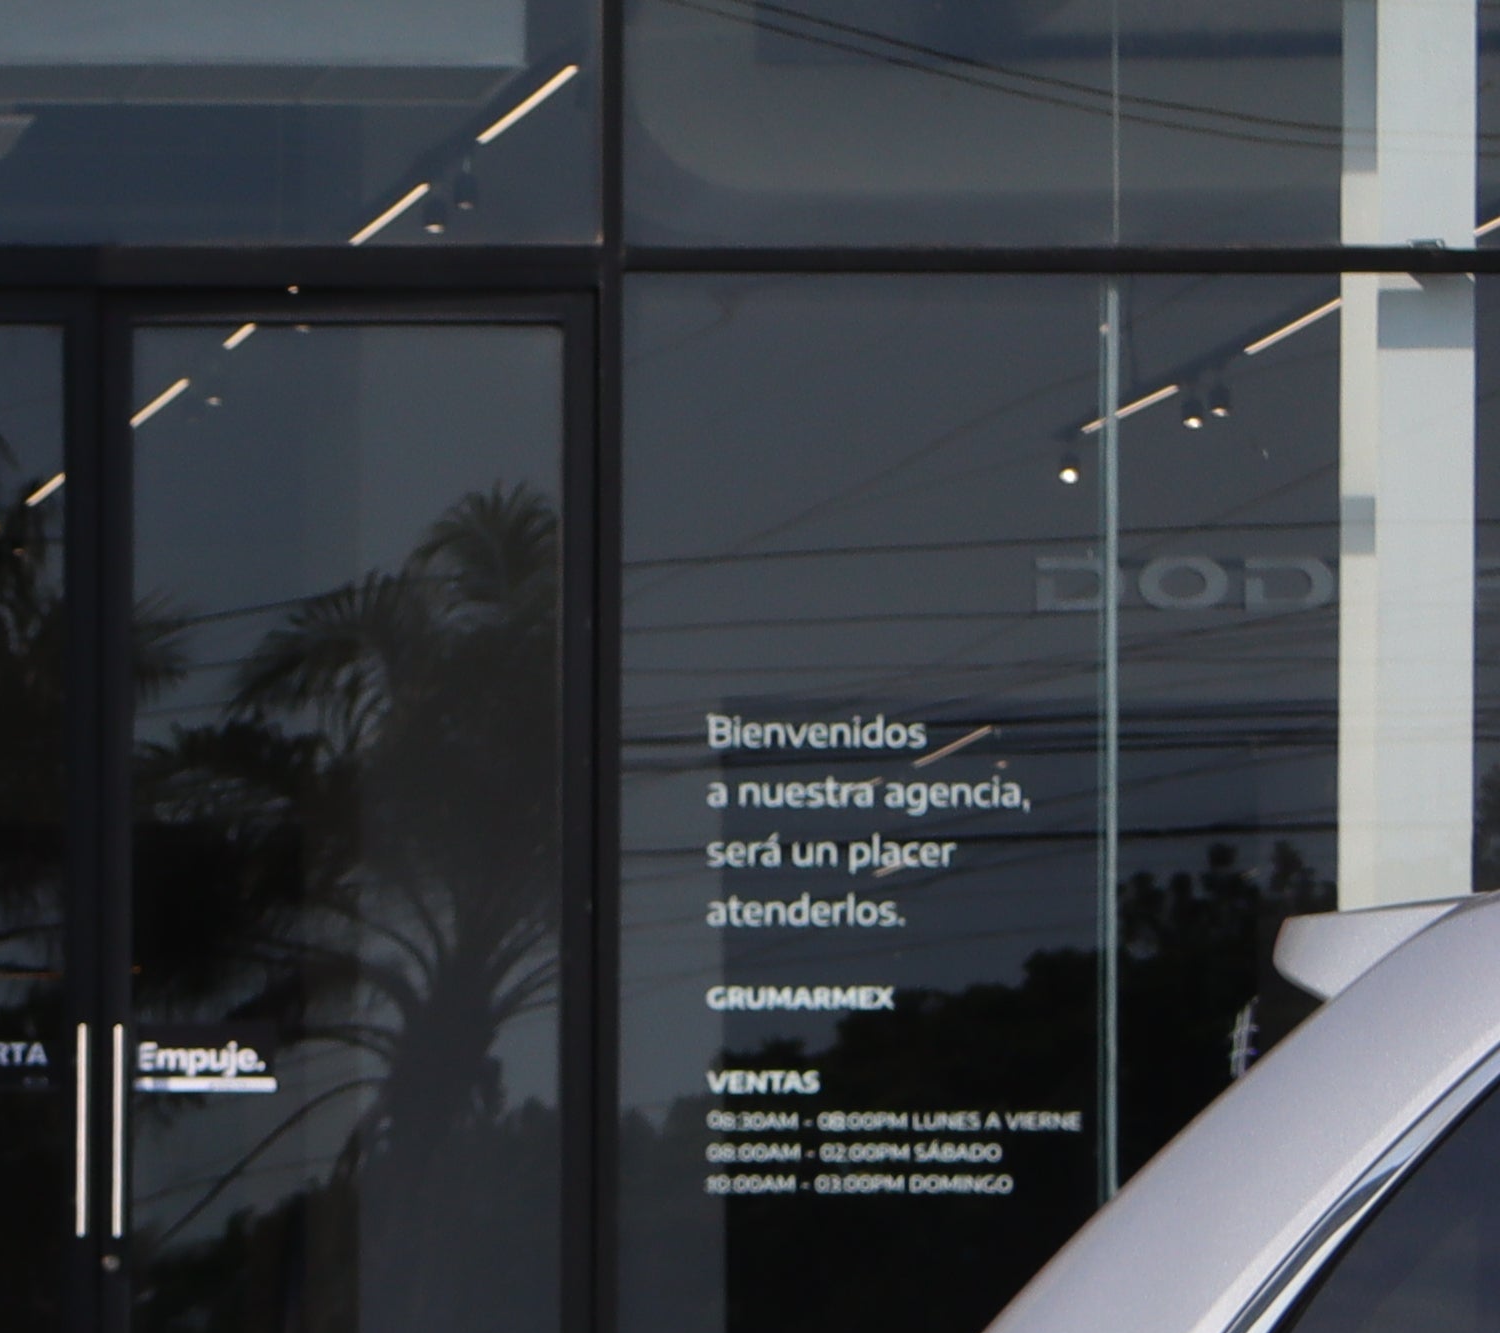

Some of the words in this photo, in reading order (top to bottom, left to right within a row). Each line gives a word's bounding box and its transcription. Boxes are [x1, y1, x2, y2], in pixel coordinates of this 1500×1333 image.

[1036, 556, 1336, 611] DOD
[706, 714, 927, 749] Bienvenidos
[706, 782, 728, 808] a
[738, 777, 874, 808] nuestra
[884, 777, 1031, 815] agencia,
[706, 834, 780, 868] será
[791, 841, 838, 867] un
[849, 834, 956, 874] placer
[706, 892, 906, 927] atenderlos.
[706, 986, 895, 1011] GRUMARMEX
[138, 1040, 266, 1077] Empuje.
[706, 1070, 820, 1094] VENTAS
[912, 1111, 981, 1131] LUNES
[985, 1111, 1002, 1131] A
[1005, 1111, 1082, 1131] VIERNE
[913, 1139, 1002, 1162] SÁBADO
[908, 1174, 1014, 1194] DOMINGO
